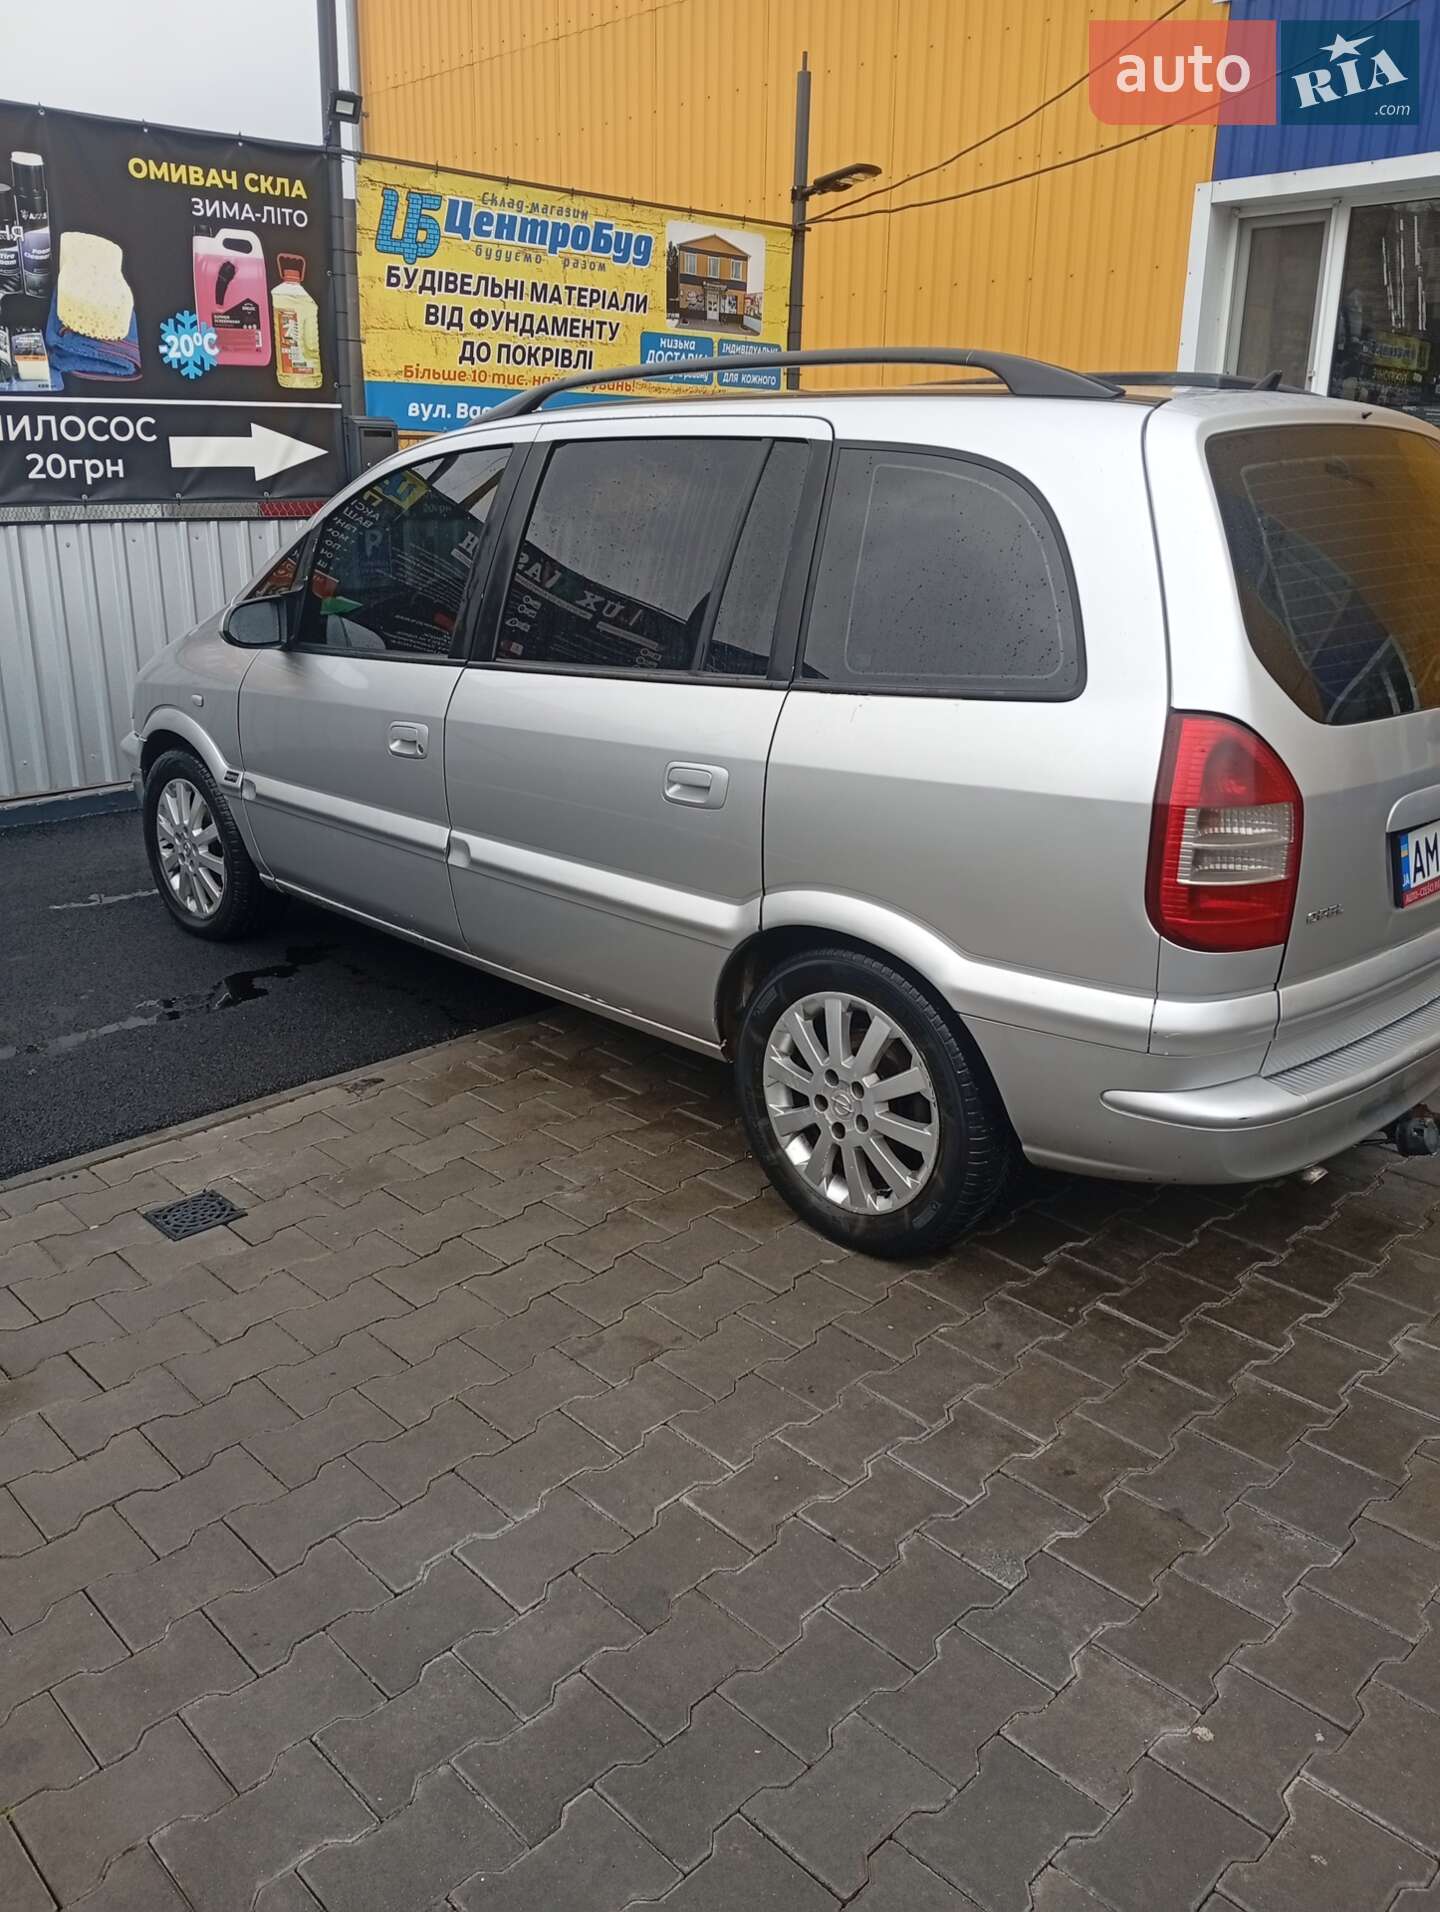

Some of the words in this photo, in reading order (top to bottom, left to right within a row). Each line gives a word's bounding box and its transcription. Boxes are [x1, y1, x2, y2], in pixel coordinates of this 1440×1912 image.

[127, 157, 238, 190] ОМИВАЧ
[244, 172, 308, 199] СКЛА
[191, 197, 308, 228] ЗИМА-ЛІТО
[445, 197, 653, 267] ЦентроБуд
[475, 245, 542, 264] будуємо
[562, 256, 606, 272] разом
[385, 264, 525, 301] БУДІВЕЛЬНІ
[530, 282, 648, 314] МАТЕРІАЛИ
[424, 304, 463, 331] ВІД
[469, 307, 620, 342] ФУНДАМЕНТУ
[458, 341, 491, 364] ДО
[496, 344, 594, 370] ПОКРІВЛІ
[403, 363, 466, 382] Більше
[471, 369, 488, 383] 10
[491, 373, 528, 387] тис.
[407, 401, 452, 421] вул.
[0, 415, 158, 442] ИЛОСОС
[25, 453, 125, 485] 20грн
[1413, 832, 1440, 883] AM
